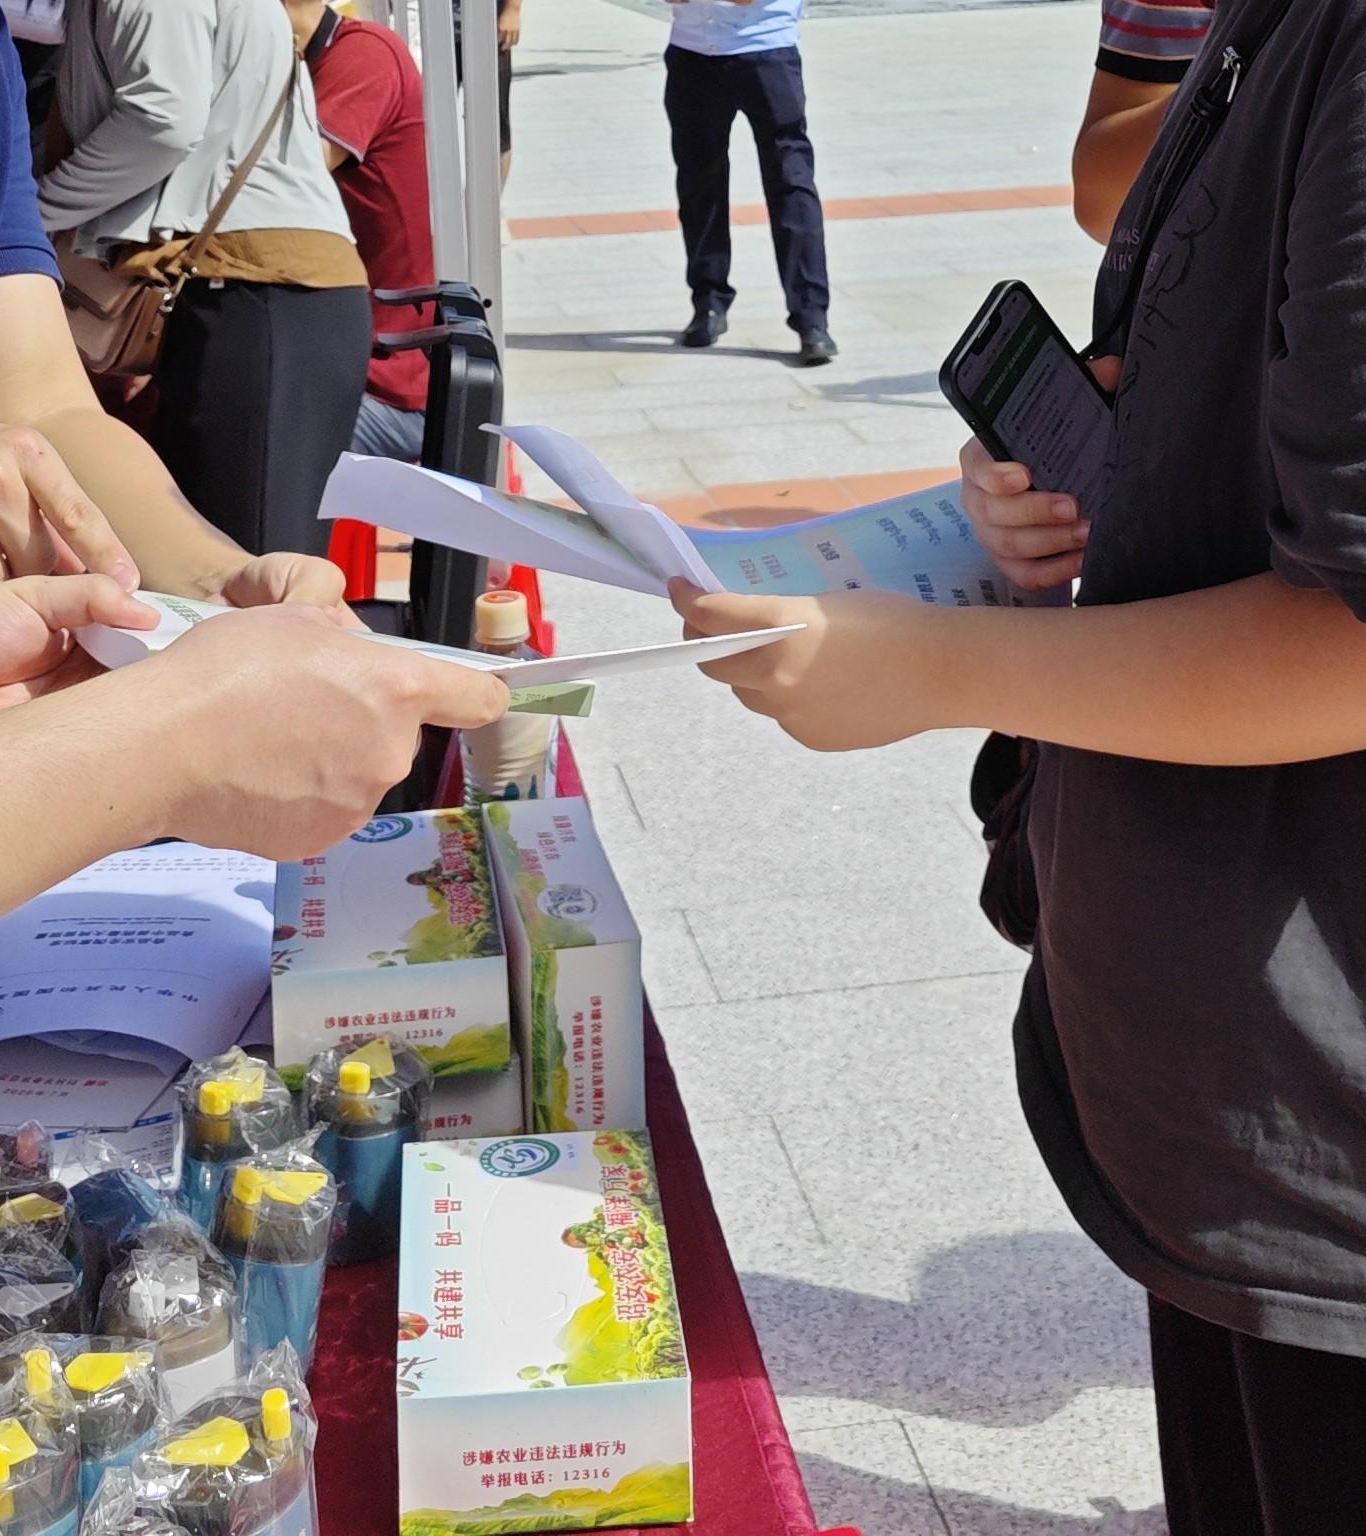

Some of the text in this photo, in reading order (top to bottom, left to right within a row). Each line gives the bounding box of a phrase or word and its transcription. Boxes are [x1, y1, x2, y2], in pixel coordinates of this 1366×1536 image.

[324, 1006, 457, 1030] 涉嫌农业违法违规行为
[433, 1182, 464, 1340] 一品一码 共建共享
[601, 1164, 648, 1322] 诏安农安 福泽万家
[462, 1439, 627, 1467] 涉嫌农业违法违规行为
